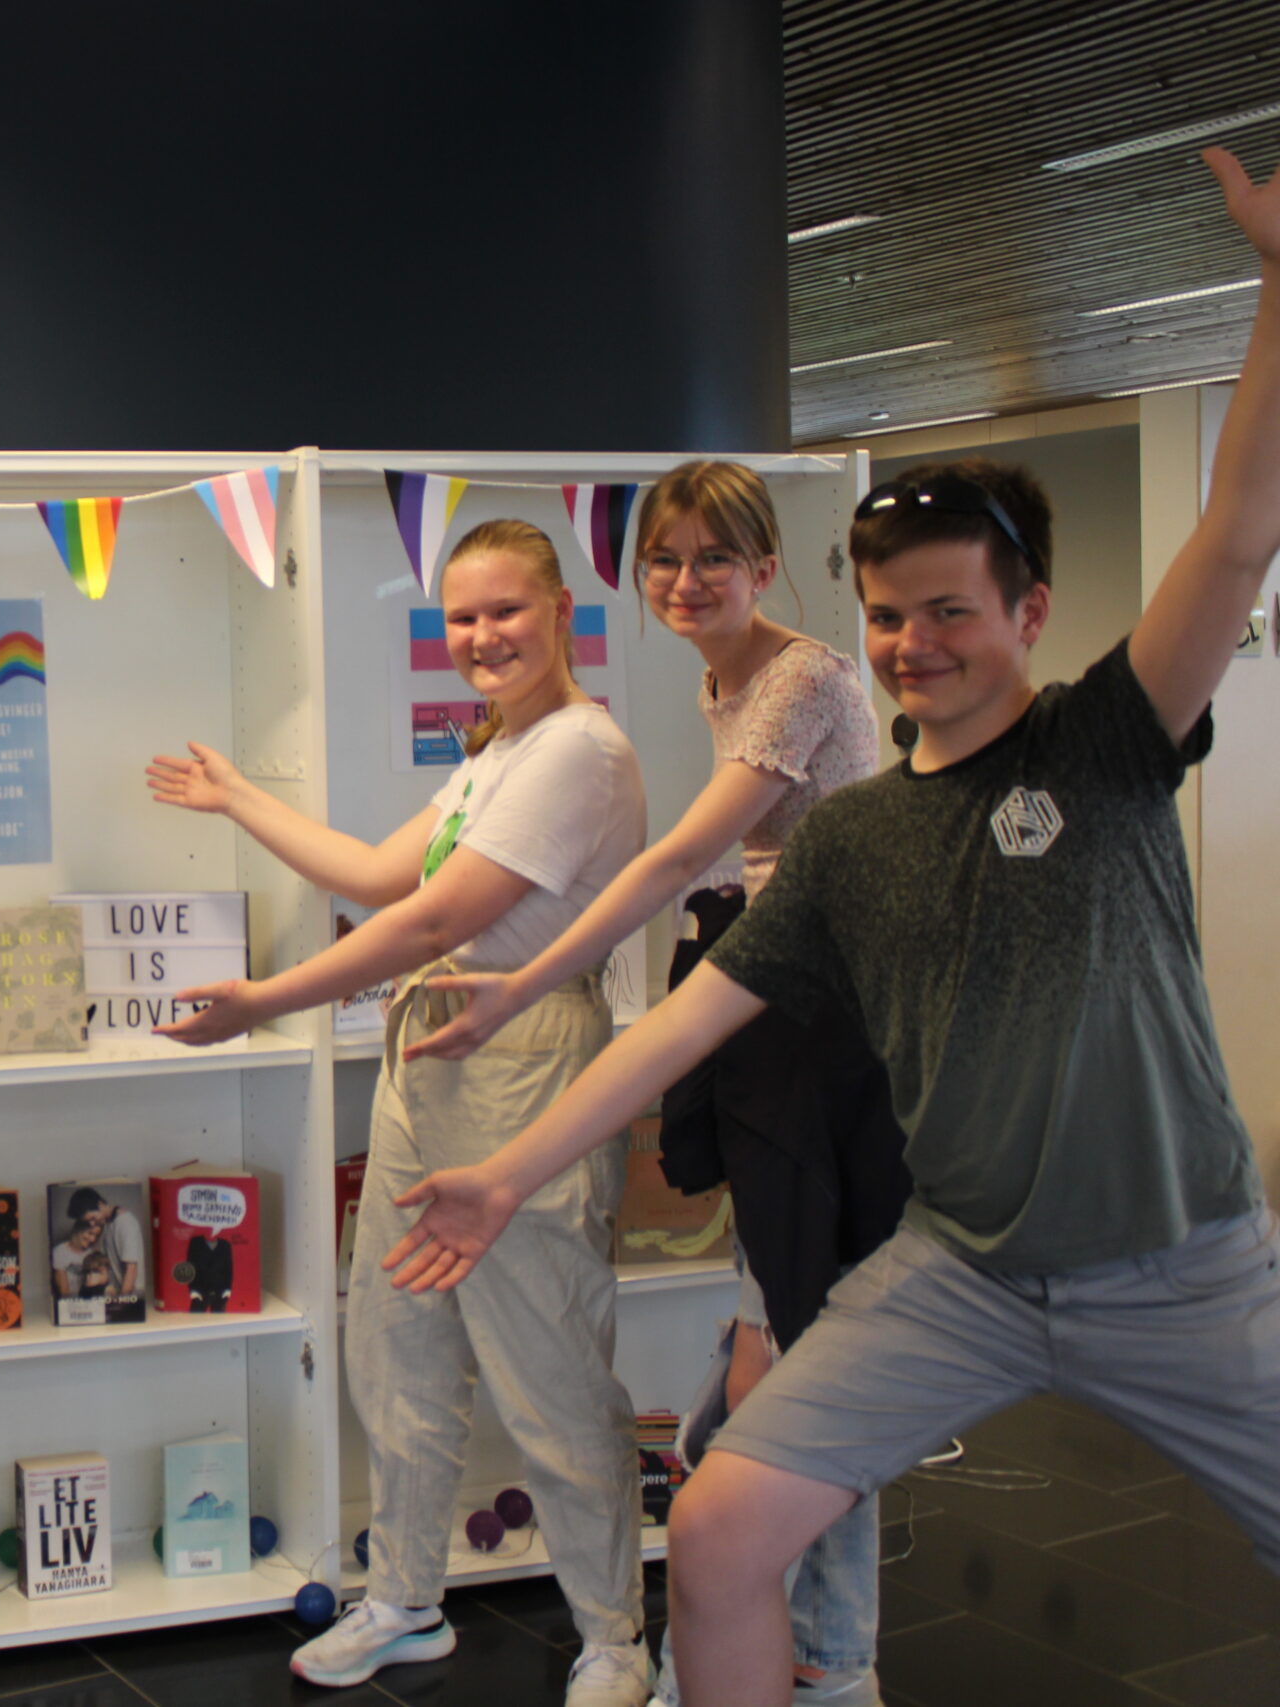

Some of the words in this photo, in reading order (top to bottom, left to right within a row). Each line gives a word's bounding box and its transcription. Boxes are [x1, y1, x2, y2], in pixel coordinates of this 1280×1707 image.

[111, 904, 190, 935] LOVE
[0, 931, 66, 947] ROSE
[1, 953, 55, 968] HAG
[130, 951, 165, 981] IS
[2, 971, 78, 988] TORN
[54, 1475, 81, 1502] ET
[39, 1499, 97, 1529] LITE
[40, 1525, 98, 1570] LIV
[34, 1574, 107, 1595] YANAGIHARA
[52, 1566, 89, 1580] HANYA
